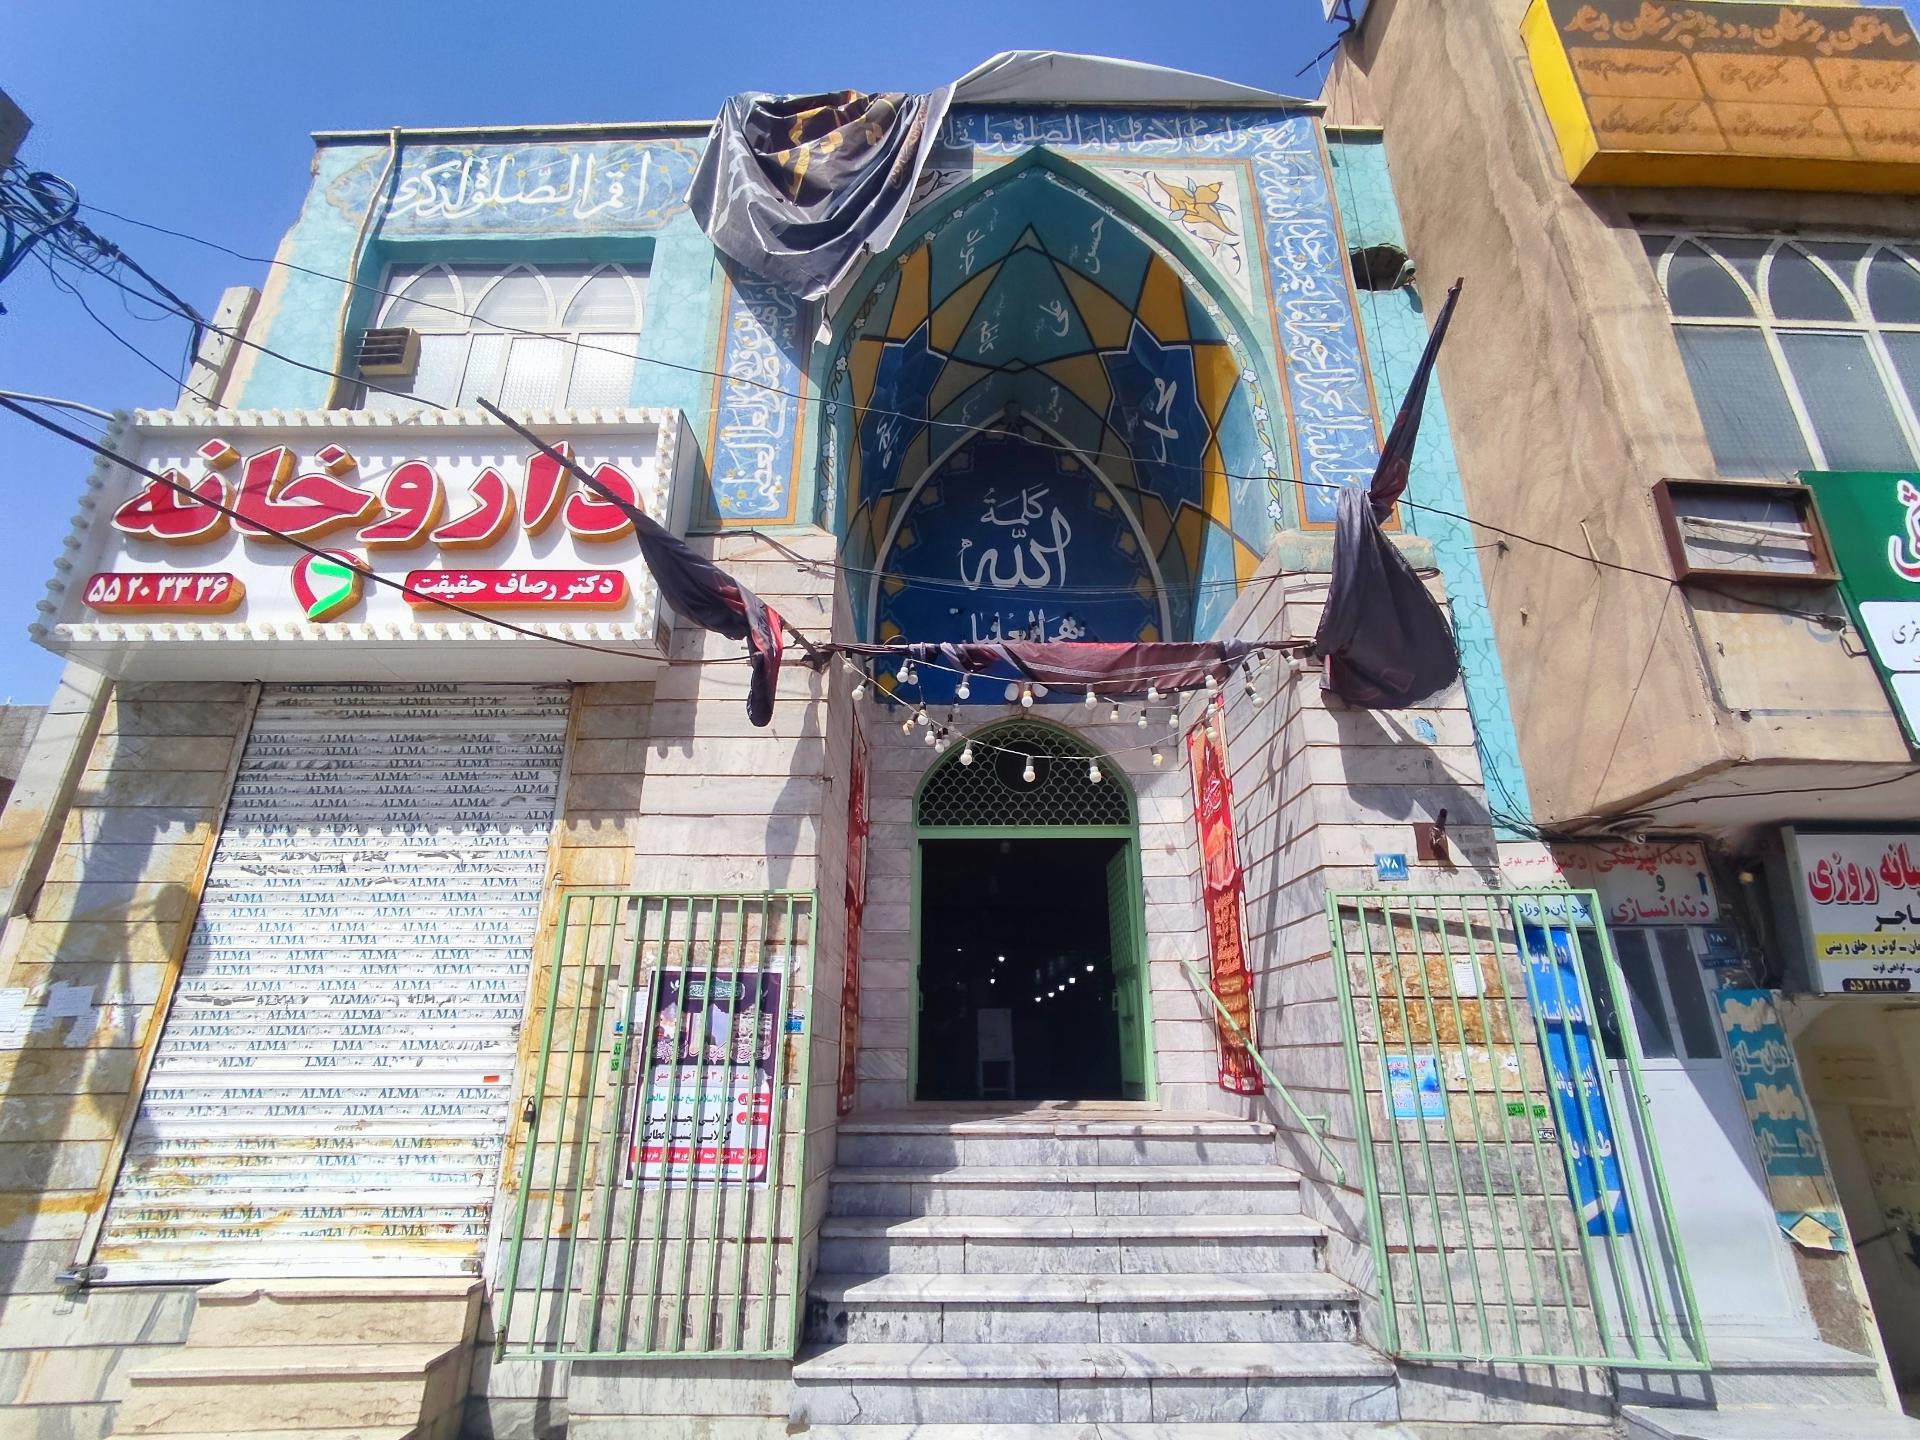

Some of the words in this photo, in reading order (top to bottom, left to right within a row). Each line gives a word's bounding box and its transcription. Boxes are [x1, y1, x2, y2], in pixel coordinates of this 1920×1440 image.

[111, 438, 640, 542] داروخانه
[414, 574, 488, 599] حقیقت
[495, 573, 557, 600] رصاف
[560, 574, 614, 600] دکتر
[1379, 856, 1399, 869] ۱۷۸
[1656, 874, 1666, 892] و
[1809, 852, 1878, 904] روزی
[1611, 897, 1711, 923] دندانسازی
